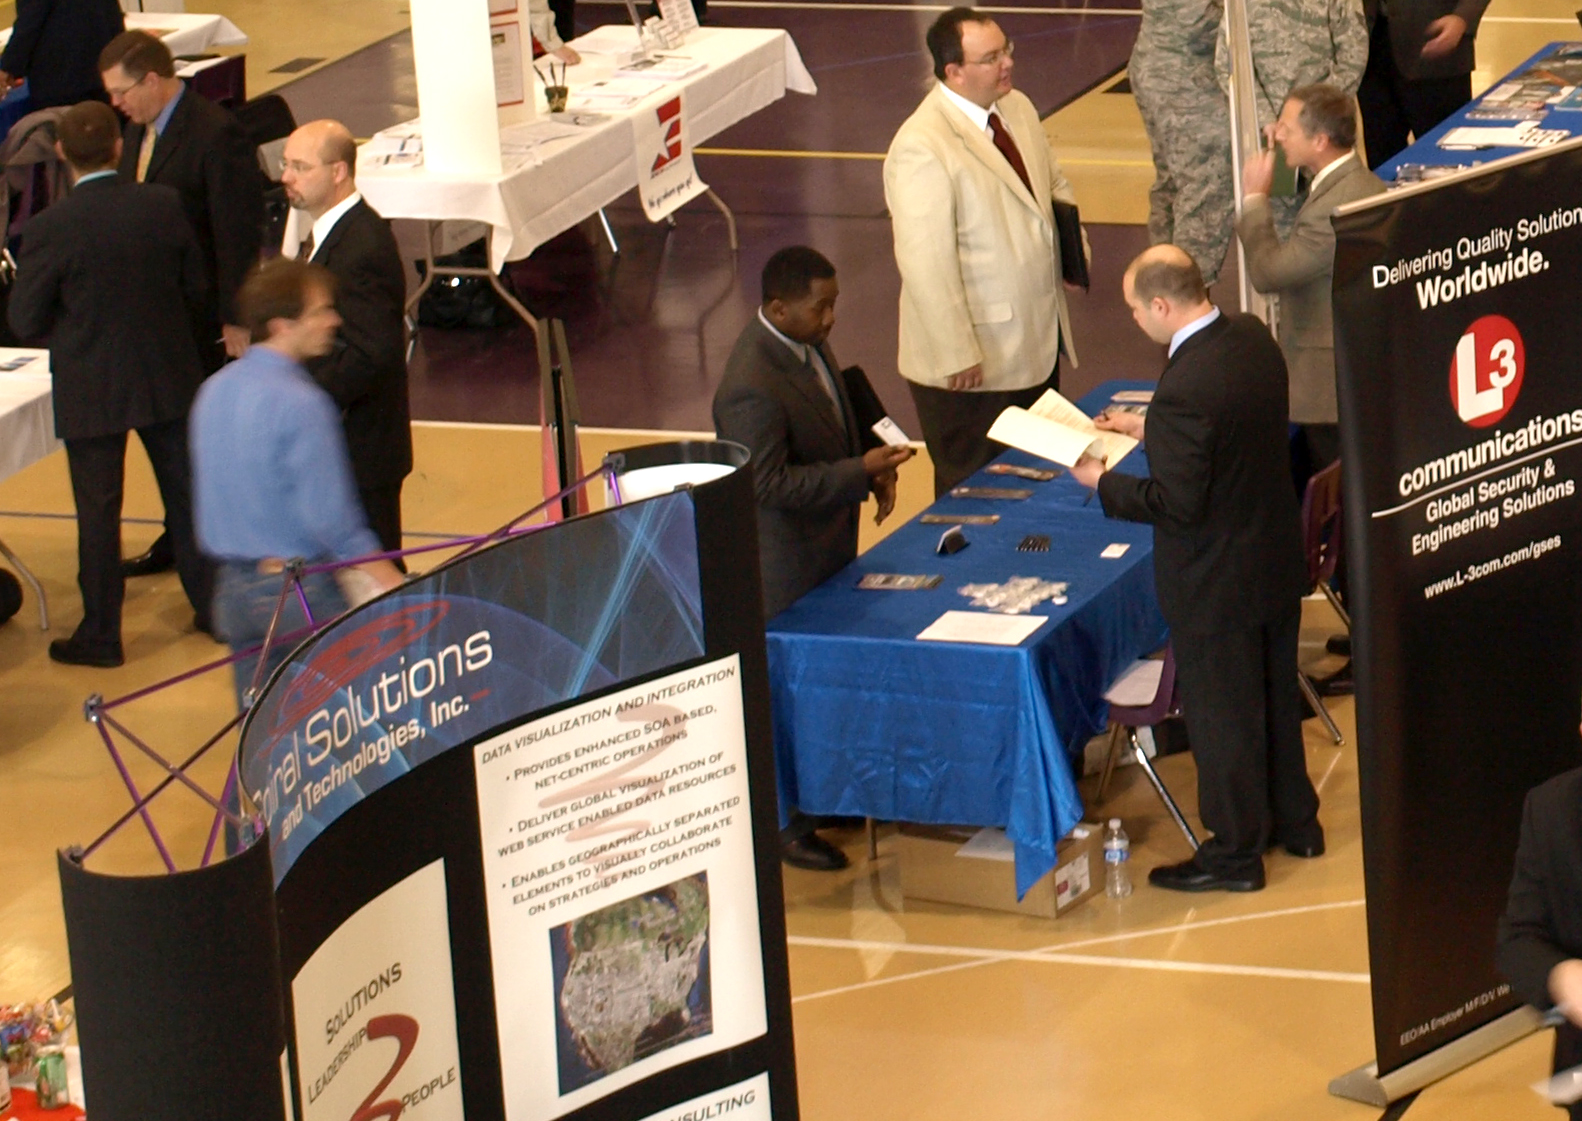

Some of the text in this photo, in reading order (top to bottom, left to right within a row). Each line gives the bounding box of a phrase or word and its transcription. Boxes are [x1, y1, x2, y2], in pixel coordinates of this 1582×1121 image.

[1372, 247, 1453, 289] Delivering
[1456, 227, 1513, 260] Quality
[1416, 247, 1550, 310] Worldwide.
[1456, 332, 1517, 423] L3
[1412, 479, 1575, 556] Engineering Solutions
[1426, 458, 1556, 523] Global Security &
[1424, 535, 1562, 599] www.L-3com.com/gses
[253, 630, 493, 827] piral Solutions
[482, 666, 736, 765] DATA VISUALIZATION AND INTEGRATION
[514, 753, 571, 780] PROVIDES
[574, 729, 641, 758] ENHANCED
[644, 717, 671, 735] SOA
[281, 694, 470, 840] and Technologies, Inc.
[518, 751, 724, 832] DELIVER GLOBAL VISUALIZATION OF
[535, 729, 688, 791] NET-CENTRIC OPERATIONS
[498, 764, 737, 857] WEB SERVICE ENABLED DATA RESOURCES
[511, 796, 740, 888] ENABLES GEOGRAPHICALLY SEPARATED
[513, 816, 733, 905] ELEMENTS TO VISUALLY COLLABORATE
[528, 837, 722, 916] ON STRATEGIES AND OPERATIONS
[326, 962, 403, 1045] SOLUTIONS
[308, 1026, 368, 1105] LEADERSHIP
[401, 1066, 457, 1113] PEOPLE
[670, 1089, 756, 1121] SULTING
